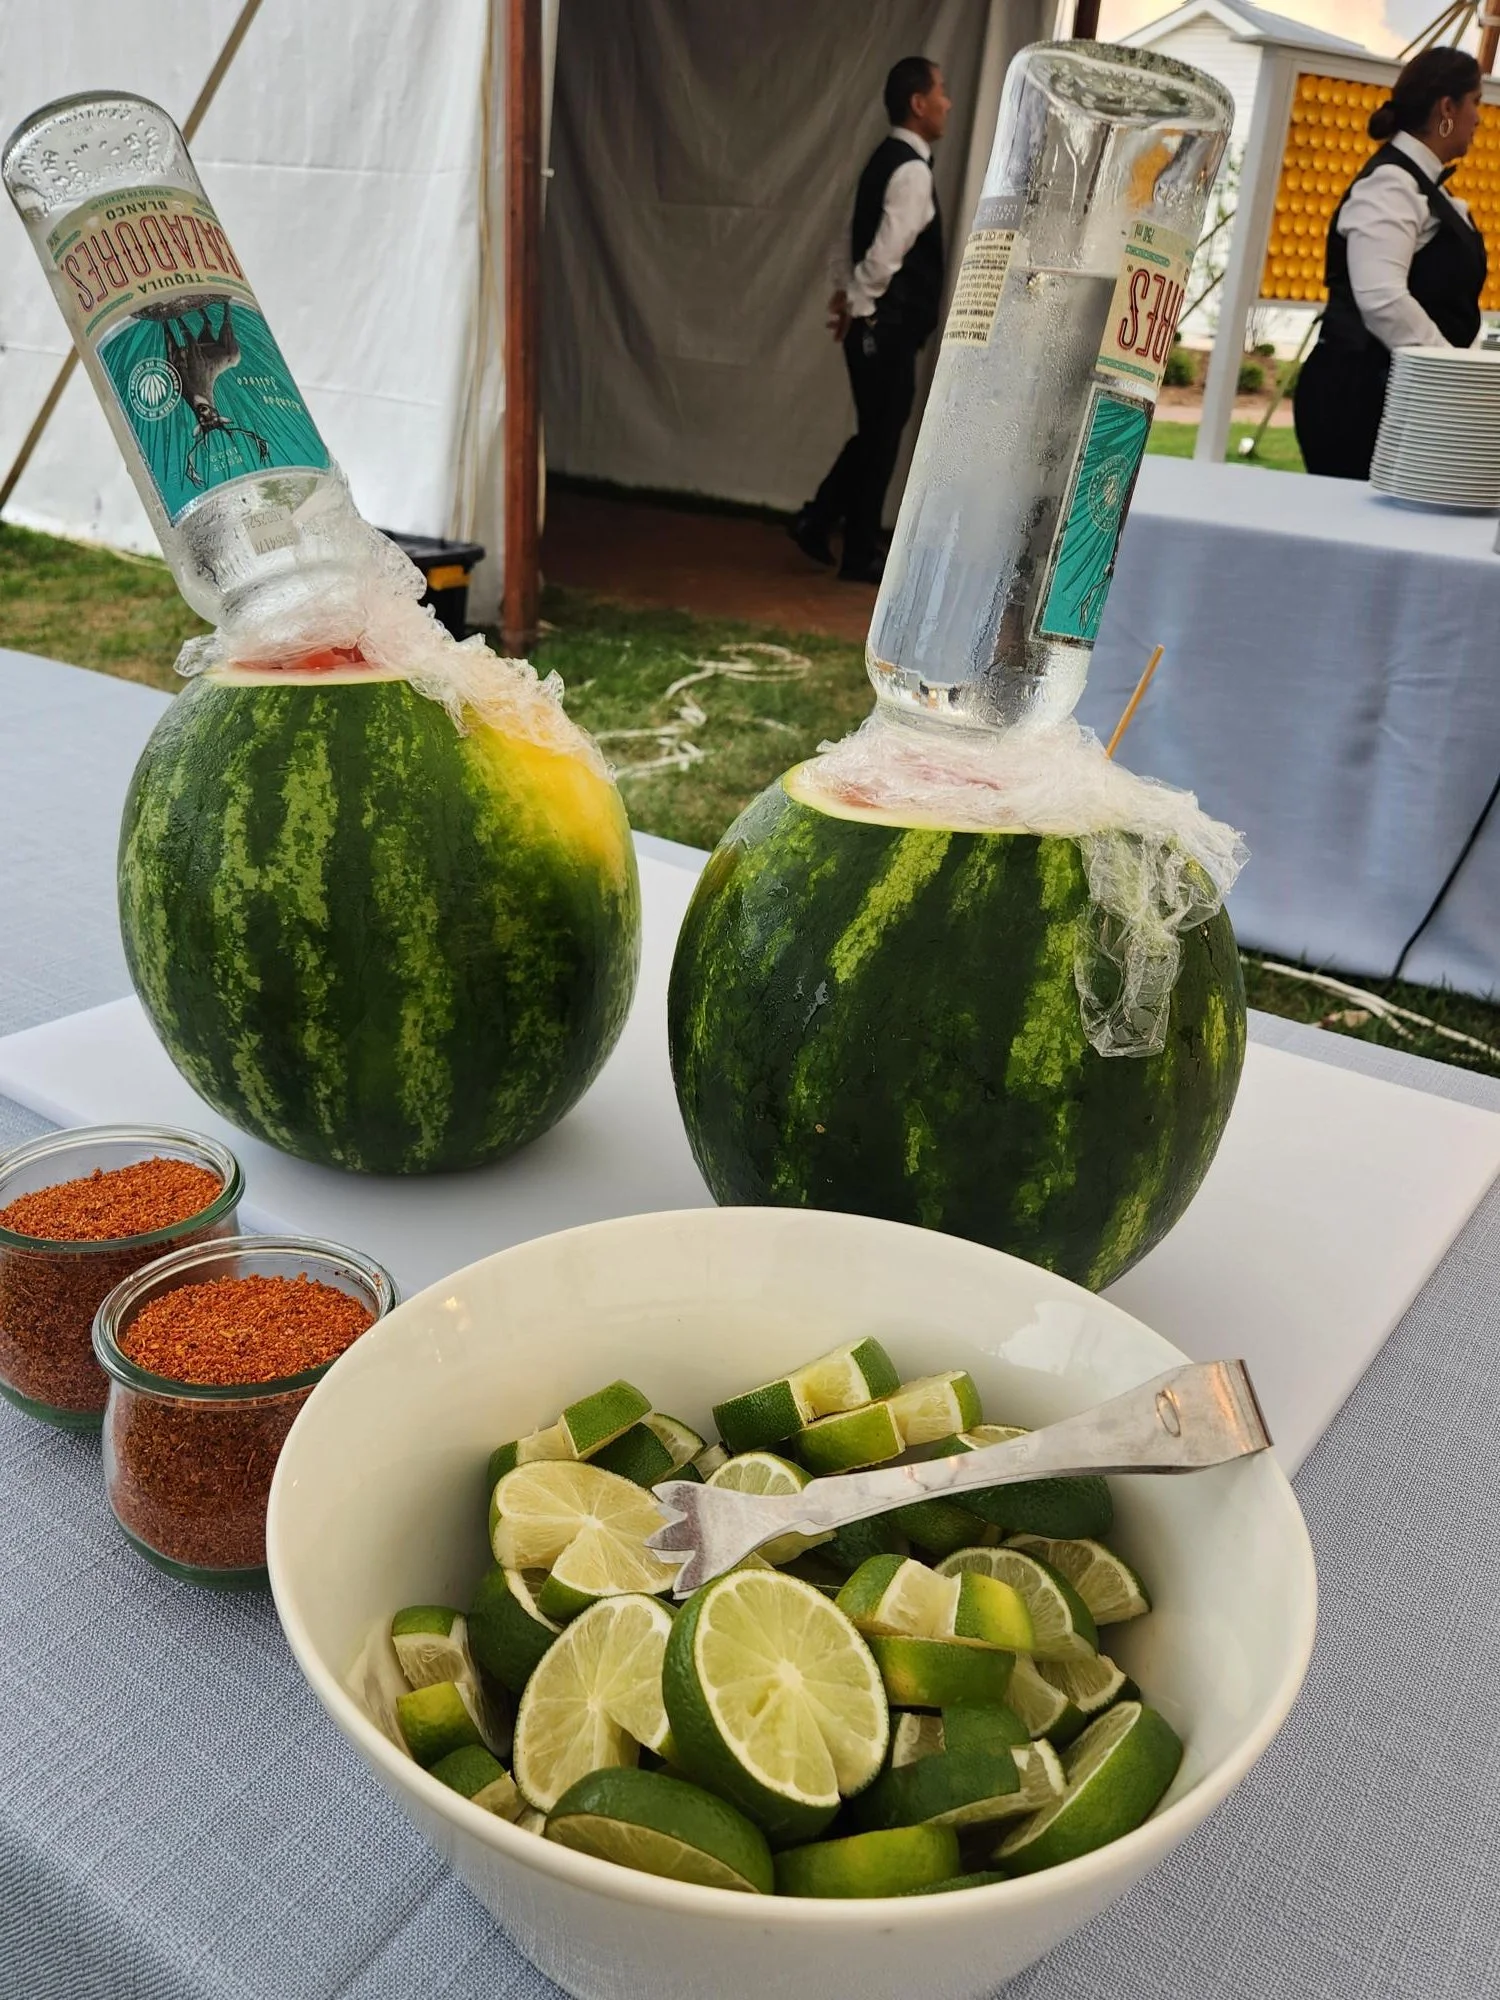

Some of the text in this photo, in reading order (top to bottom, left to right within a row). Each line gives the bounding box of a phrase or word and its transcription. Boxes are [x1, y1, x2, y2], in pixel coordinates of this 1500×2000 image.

[106, 200, 168, 220] BLANCO
[64, 214, 244, 313] CAZADORES
[137, 272, 206, 294] TEQUILA
